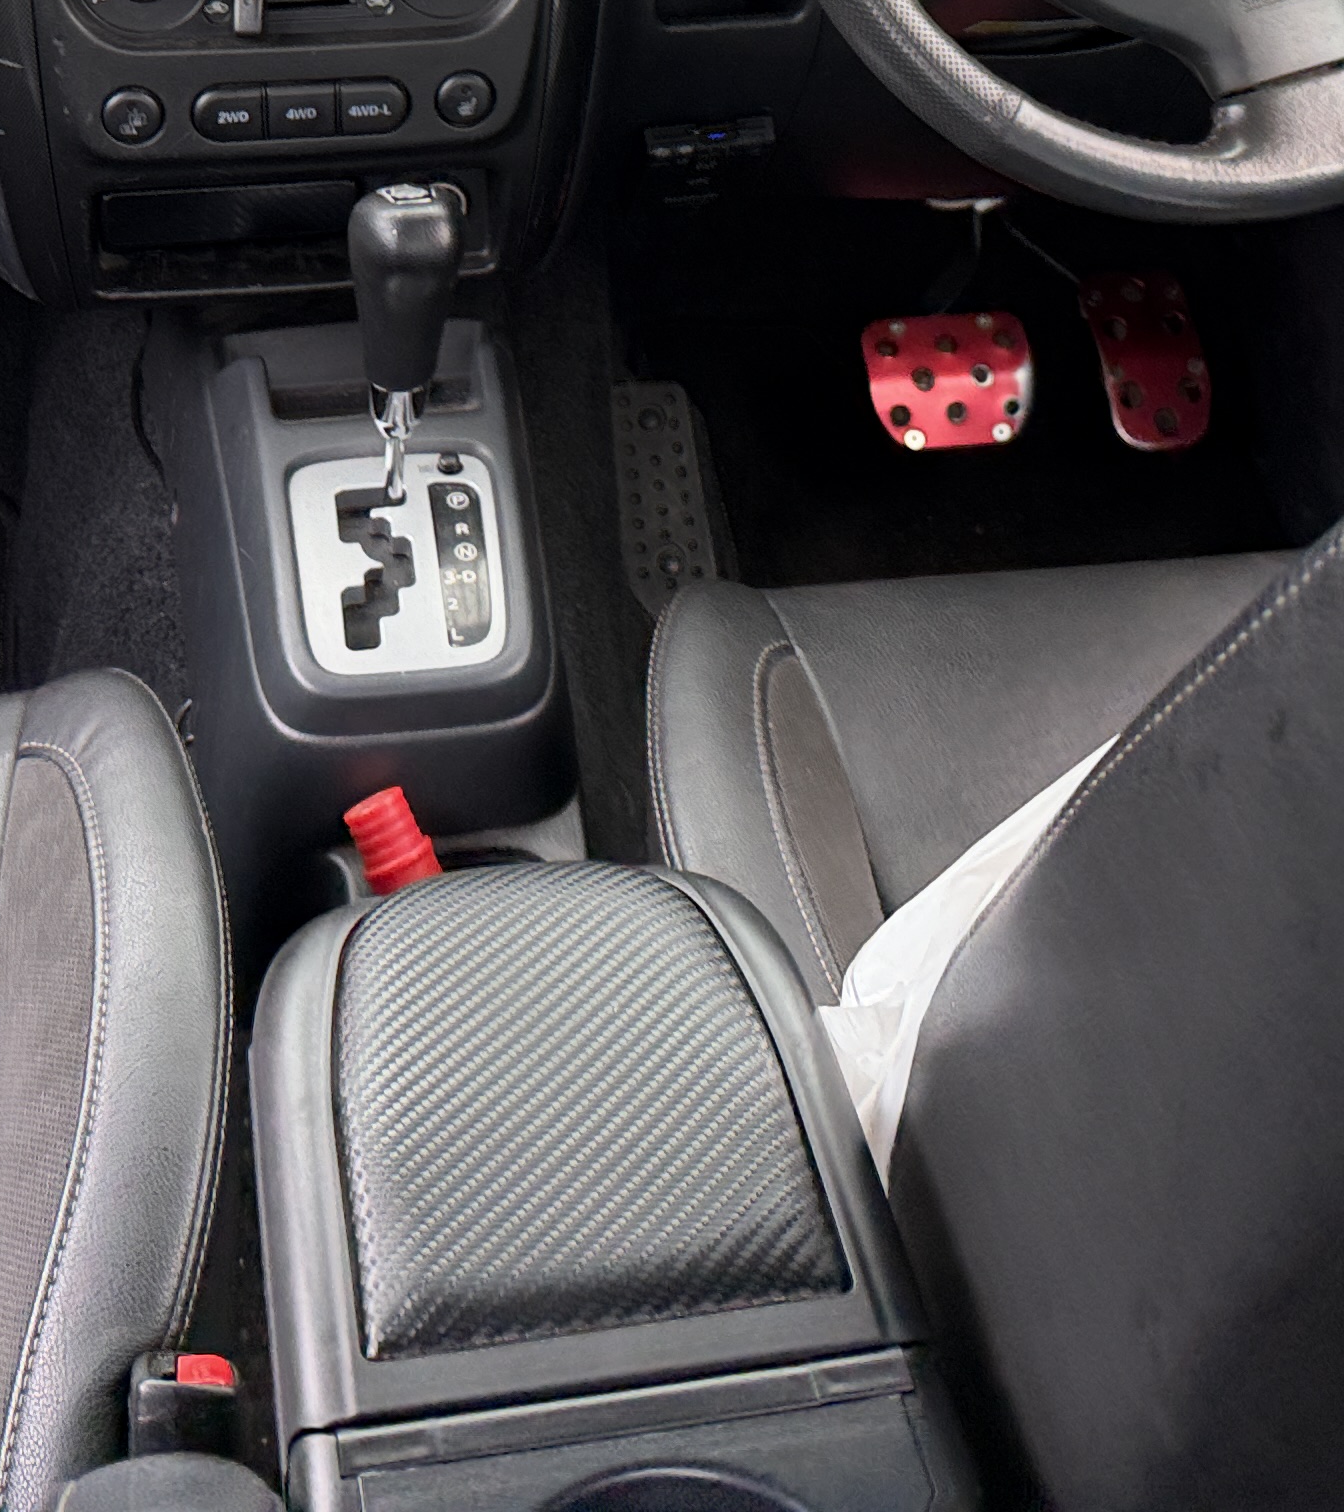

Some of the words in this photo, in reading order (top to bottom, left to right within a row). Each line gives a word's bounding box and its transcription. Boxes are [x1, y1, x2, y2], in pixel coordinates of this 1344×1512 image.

[285, 107, 317, 120] 4WD
[348, 103, 392, 117] 4WD-L
[217, 110, 250, 125] 2WD
[454, 522, 470, 535] R
[447, 598, 459, 611] 2
[450, 627, 465, 642] L
